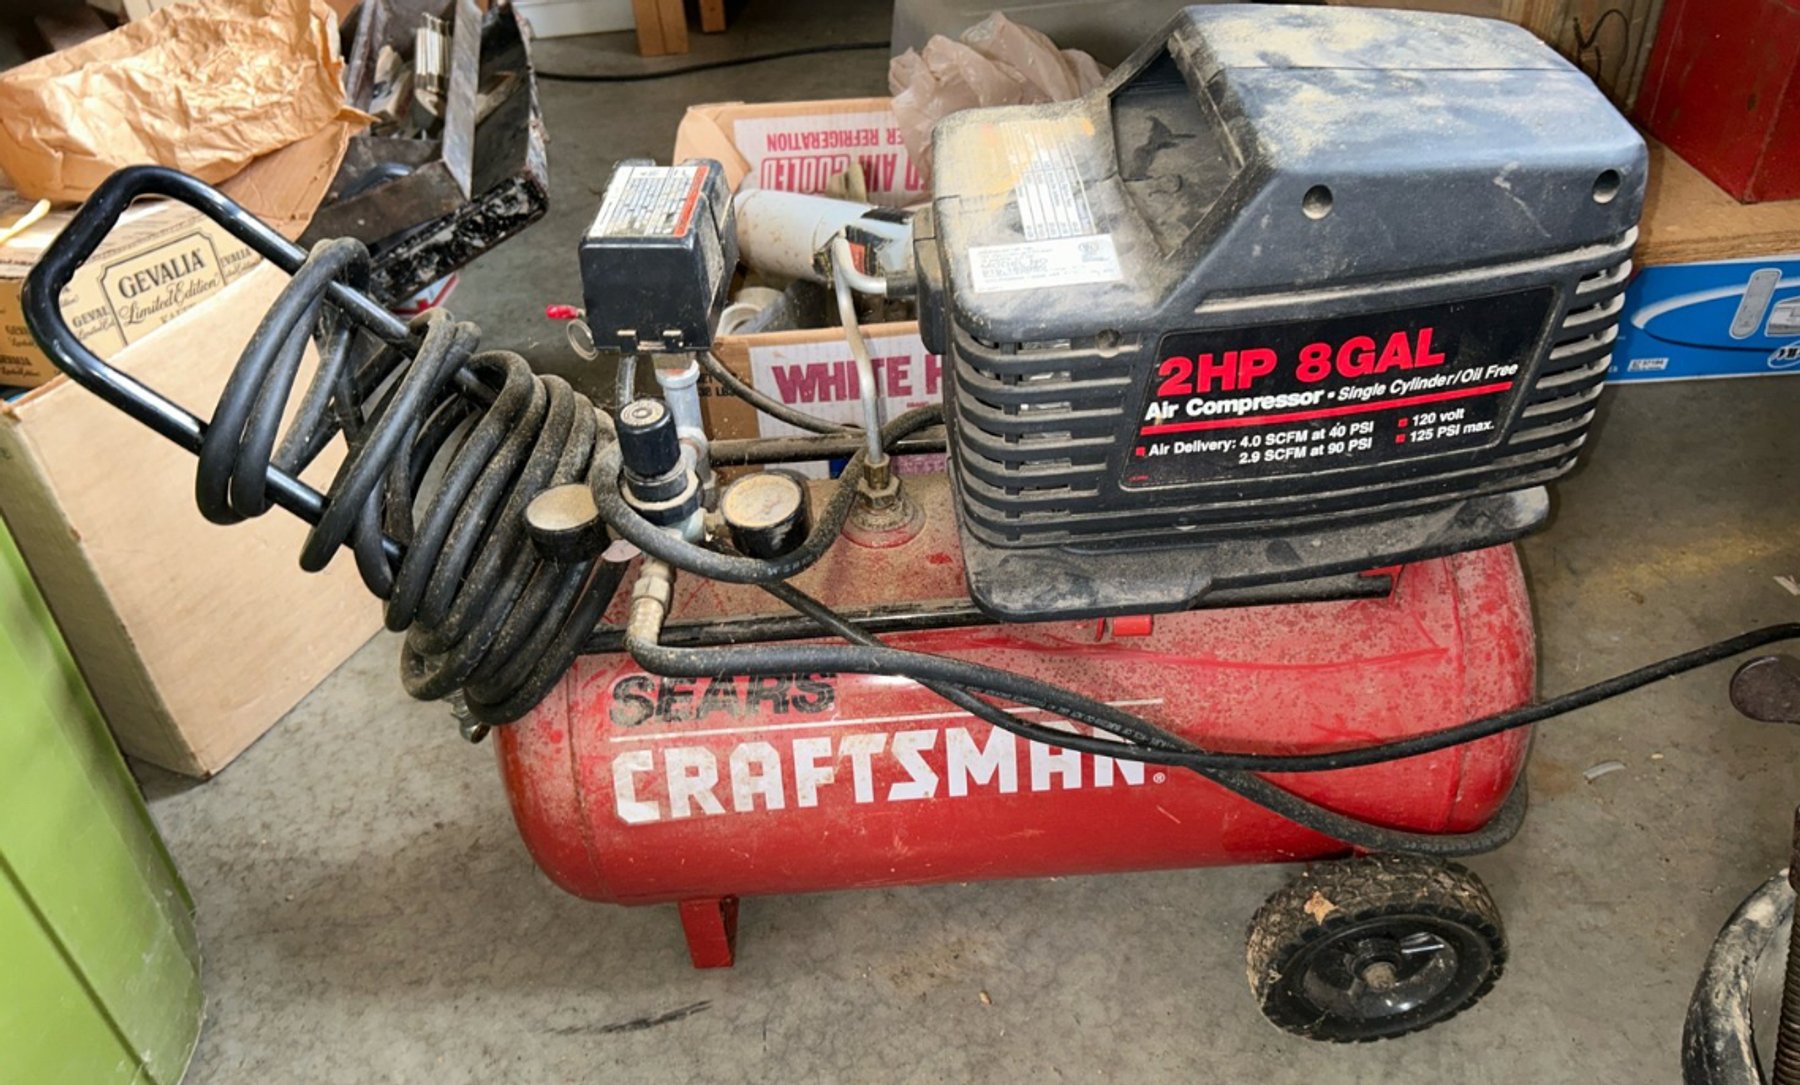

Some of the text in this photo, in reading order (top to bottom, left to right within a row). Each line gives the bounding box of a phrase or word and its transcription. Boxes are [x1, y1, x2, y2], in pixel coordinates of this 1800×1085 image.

[767, 128, 879, 151] REFRIGERATION
[118, 249, 206, 299] GEVALIA
[118, 285, 174, 325] Limited
[169, 277, 219, 306] Edition
[771, 356, 912, 404] WHITE
[1157, 327, 1445, 397] 2HP 8GAL
[1145, 400, 1178, 421] Air
[1186, 390, 1324, 417] Compressor
[1338, 382, 1386, 401] Single
[1485, 363, 1519, 380] Free
[1149, 421, 1375, 457] Air Delivery: 4.0 SCFM at 40 PSI
[1410, 421, 1495, 443] 125 PSI max.
[1412, 408, 1465, 427] 120 volt
[1238, 437, 1373, 464] 2.9 SCFM at 90 PSI
[609, 672, 836, 726] SEARS
[612, 720, 1145, 824] CRAFTSMAN
